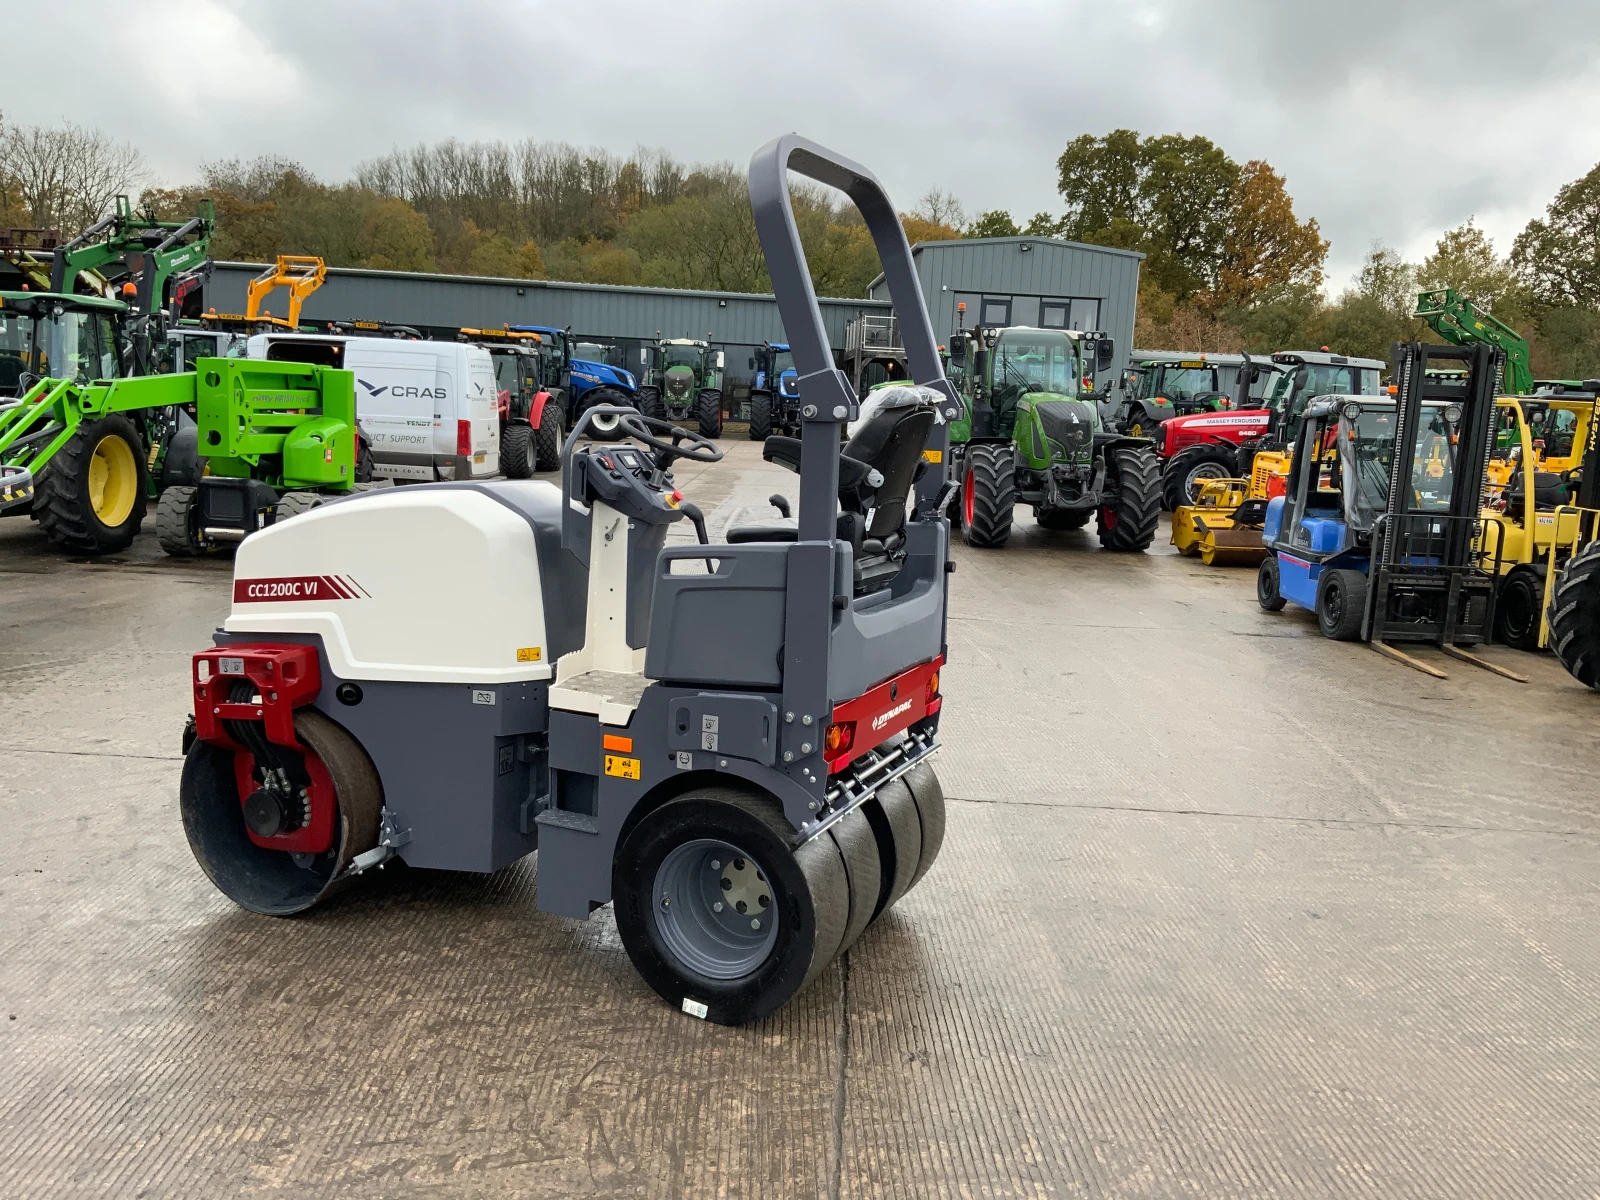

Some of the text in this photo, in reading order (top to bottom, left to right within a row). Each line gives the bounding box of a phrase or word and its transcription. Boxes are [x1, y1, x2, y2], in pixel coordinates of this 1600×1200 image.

[391, 385, 447, 399] CRAS
[390, 434, 427, 444] SUPPORT
[248, 581, 318, 598] CC1200C VI
[877, 698, 913, 726] DYNAPAC
